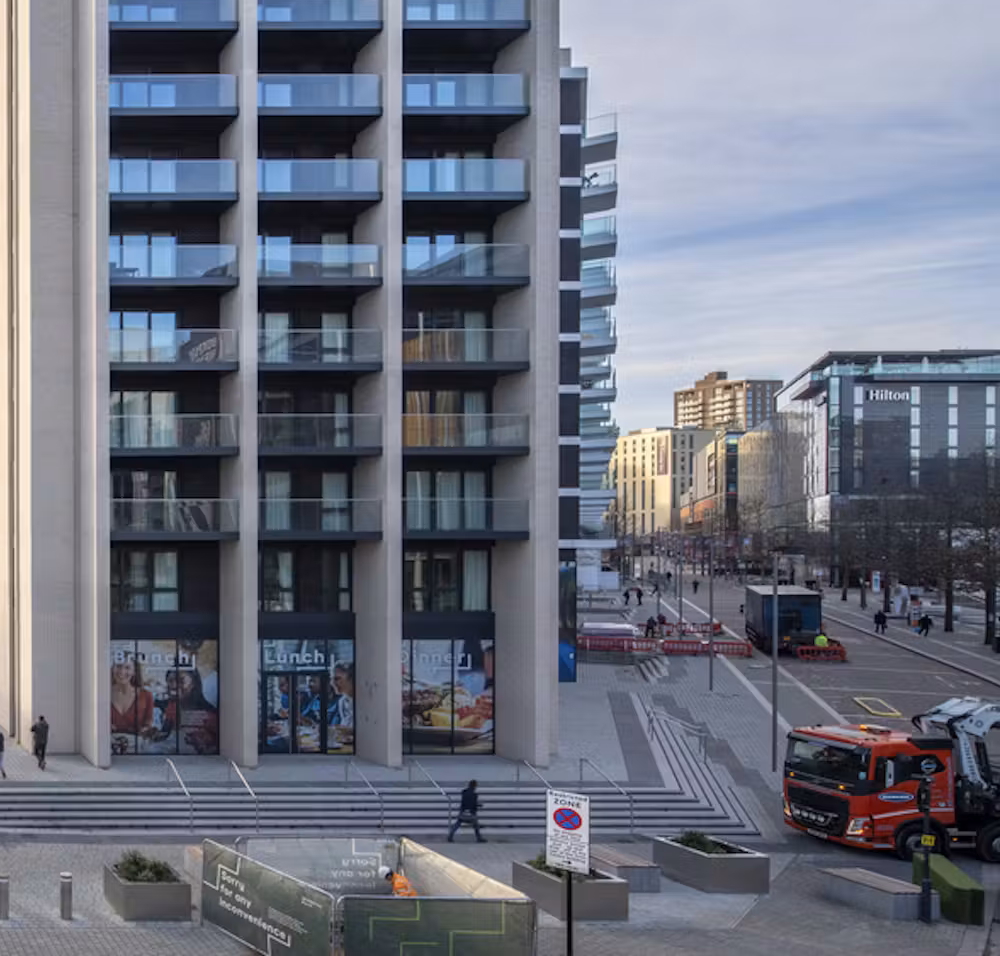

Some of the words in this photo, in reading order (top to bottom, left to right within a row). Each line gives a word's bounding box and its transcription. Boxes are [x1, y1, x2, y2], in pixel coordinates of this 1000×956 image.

[870, 389, 910, 402] Hilton
[114, 649, 189, 664] Brunch
[264, 649, 325, 664] Lunch
[221, 870, 245, 893] Sorry
[220, 884, 233, 898] for
[234, 893, 252, 909] any
[219, 896, 286, 940] Inconvenience
